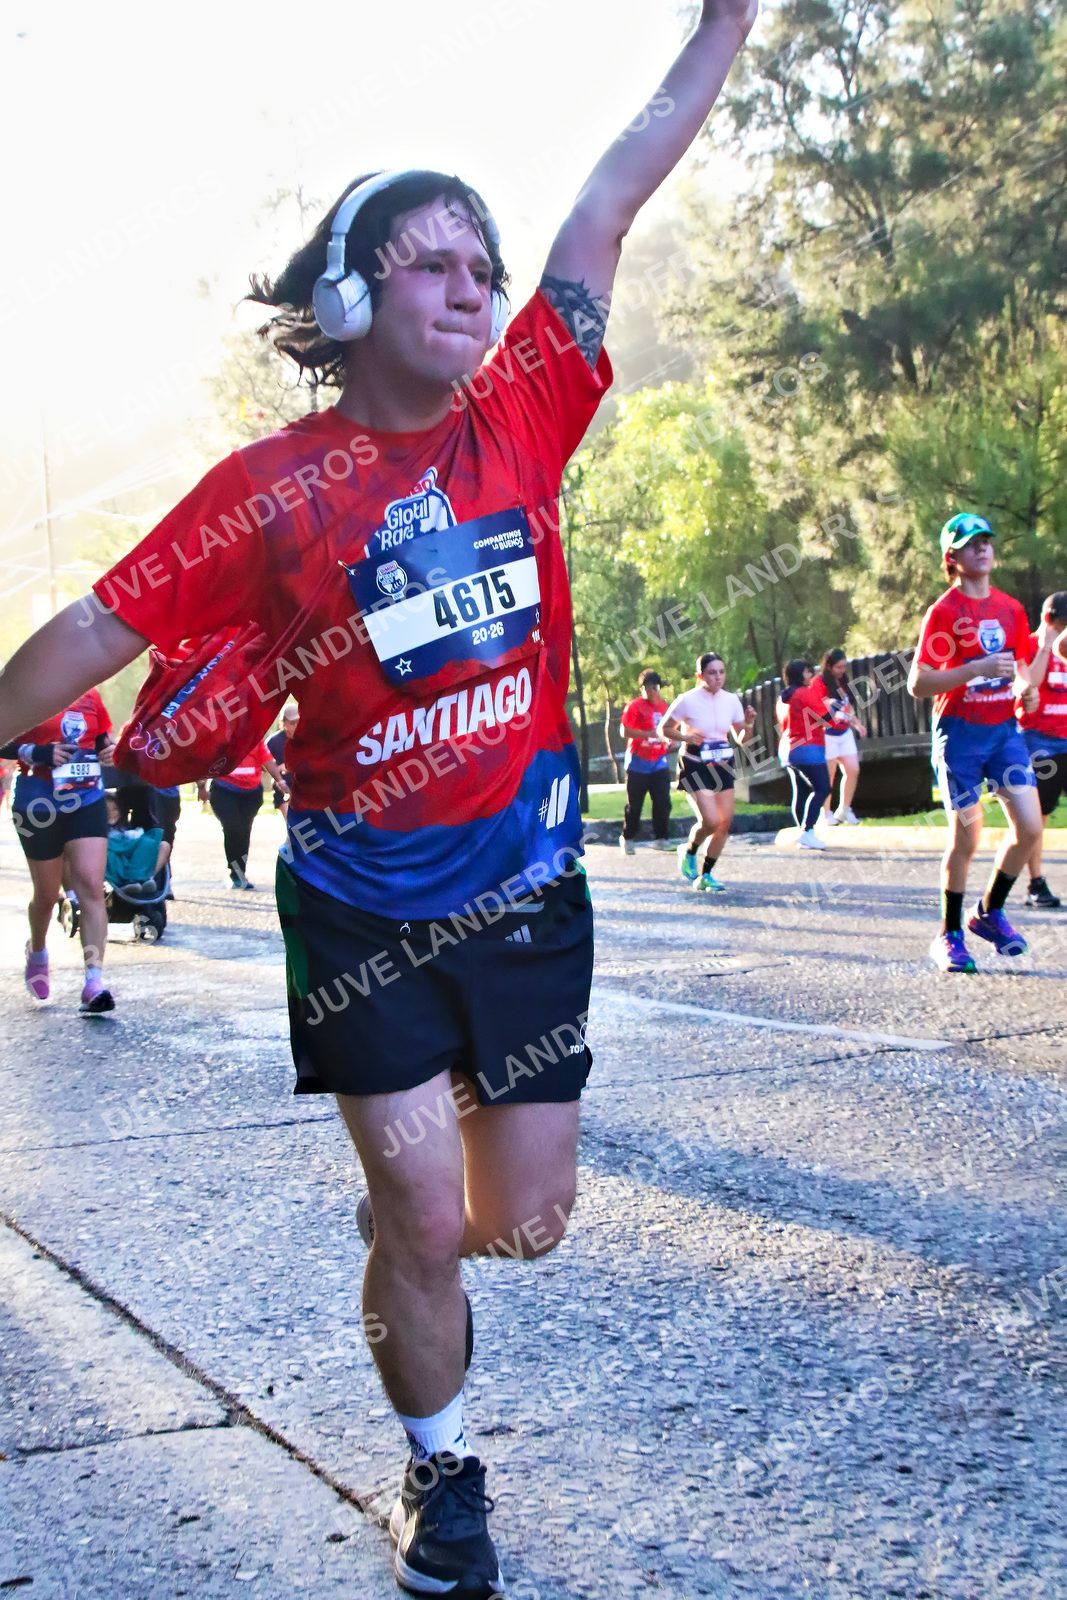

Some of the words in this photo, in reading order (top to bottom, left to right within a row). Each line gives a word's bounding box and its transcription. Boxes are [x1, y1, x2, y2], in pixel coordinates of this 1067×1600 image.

[473, 529, 522, 549] COMPARTIMOS
[433, 569, 516, 629] 4675
[356, 667, 532, 765] SANTIAGO
